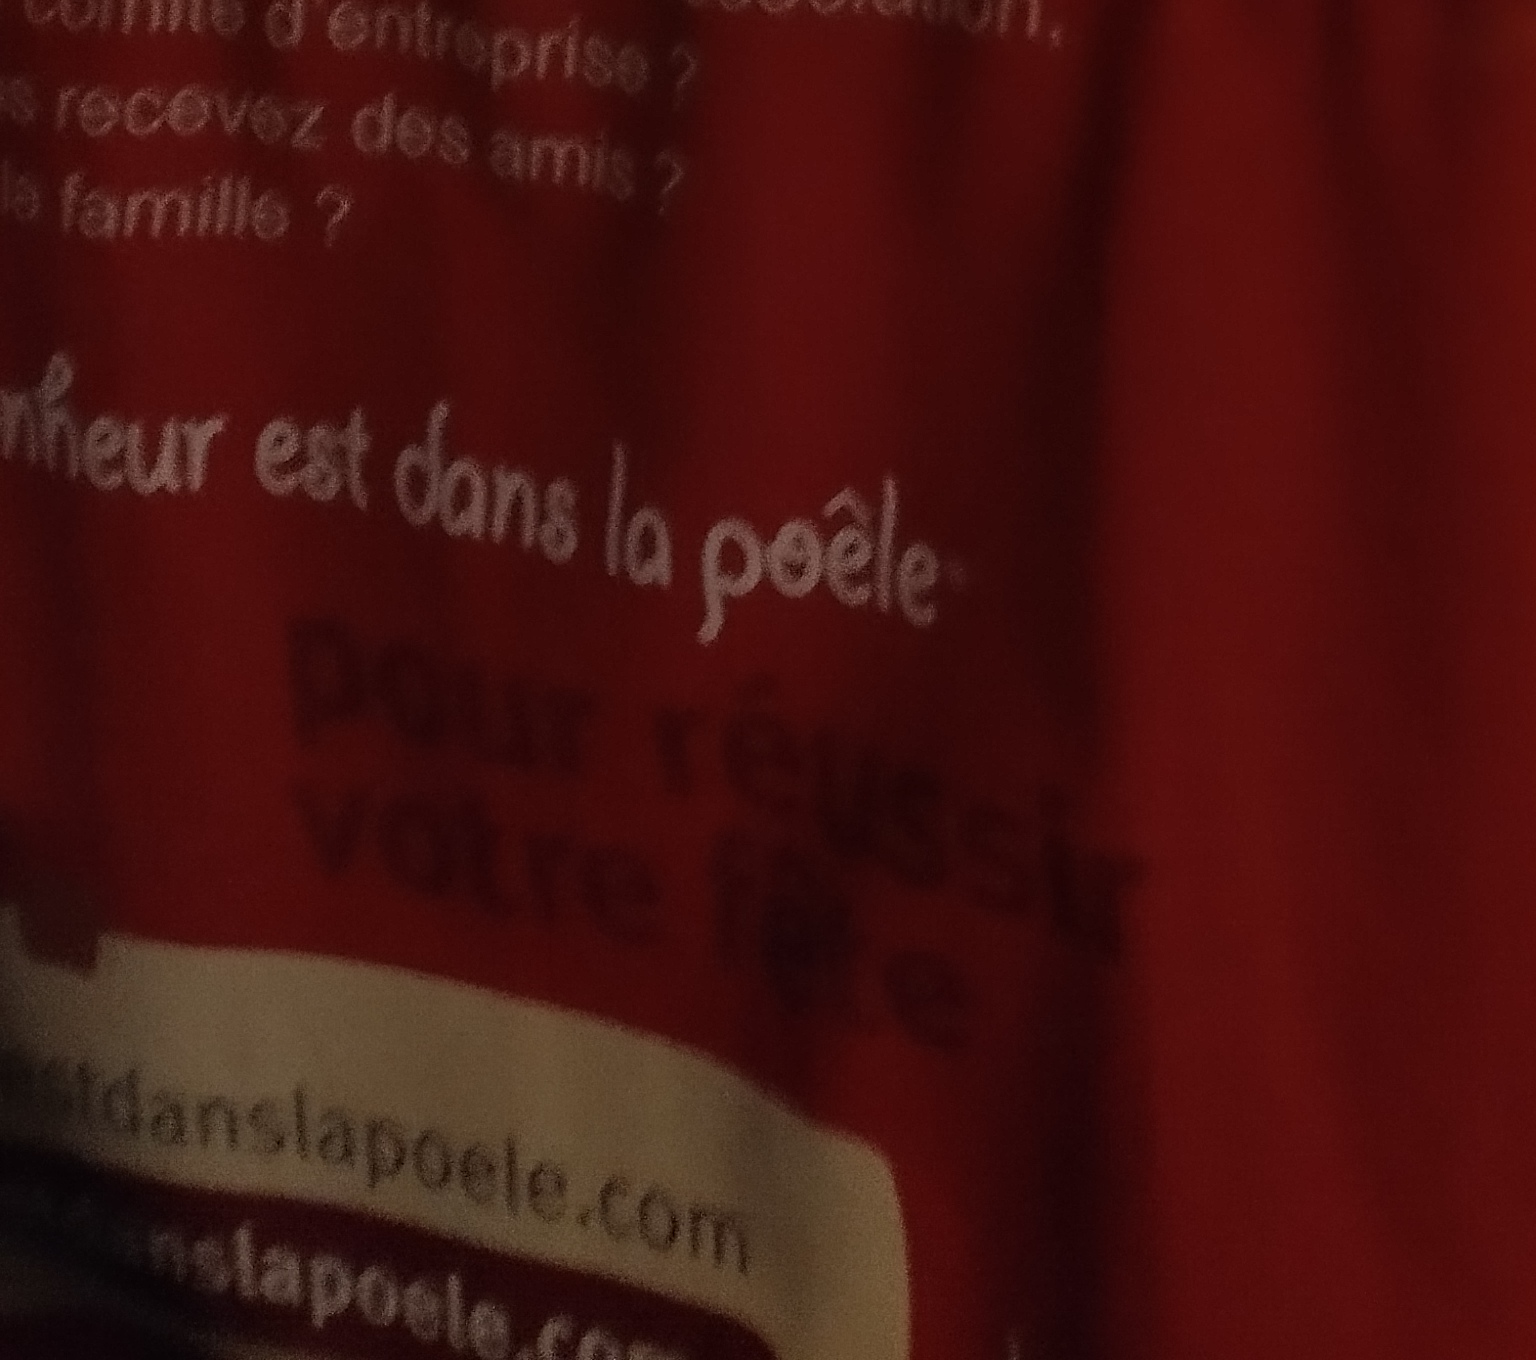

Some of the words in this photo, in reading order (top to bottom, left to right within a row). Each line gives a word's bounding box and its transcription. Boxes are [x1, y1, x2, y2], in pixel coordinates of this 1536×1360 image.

[54, 83, 326, 152] recevez
[352, 94, 470, 167] des
[490, 132, 636, 200] amis
[58, 170, 291, 243] famille
[315, 186, 352, 248] ?
[0, 350, 230, 497] nheur
[255, 400, 370, 510] est
[394, 397, 579, 566] dans
[603, 439, 673, 589] la
[697, 474, 940, 648] poêle
